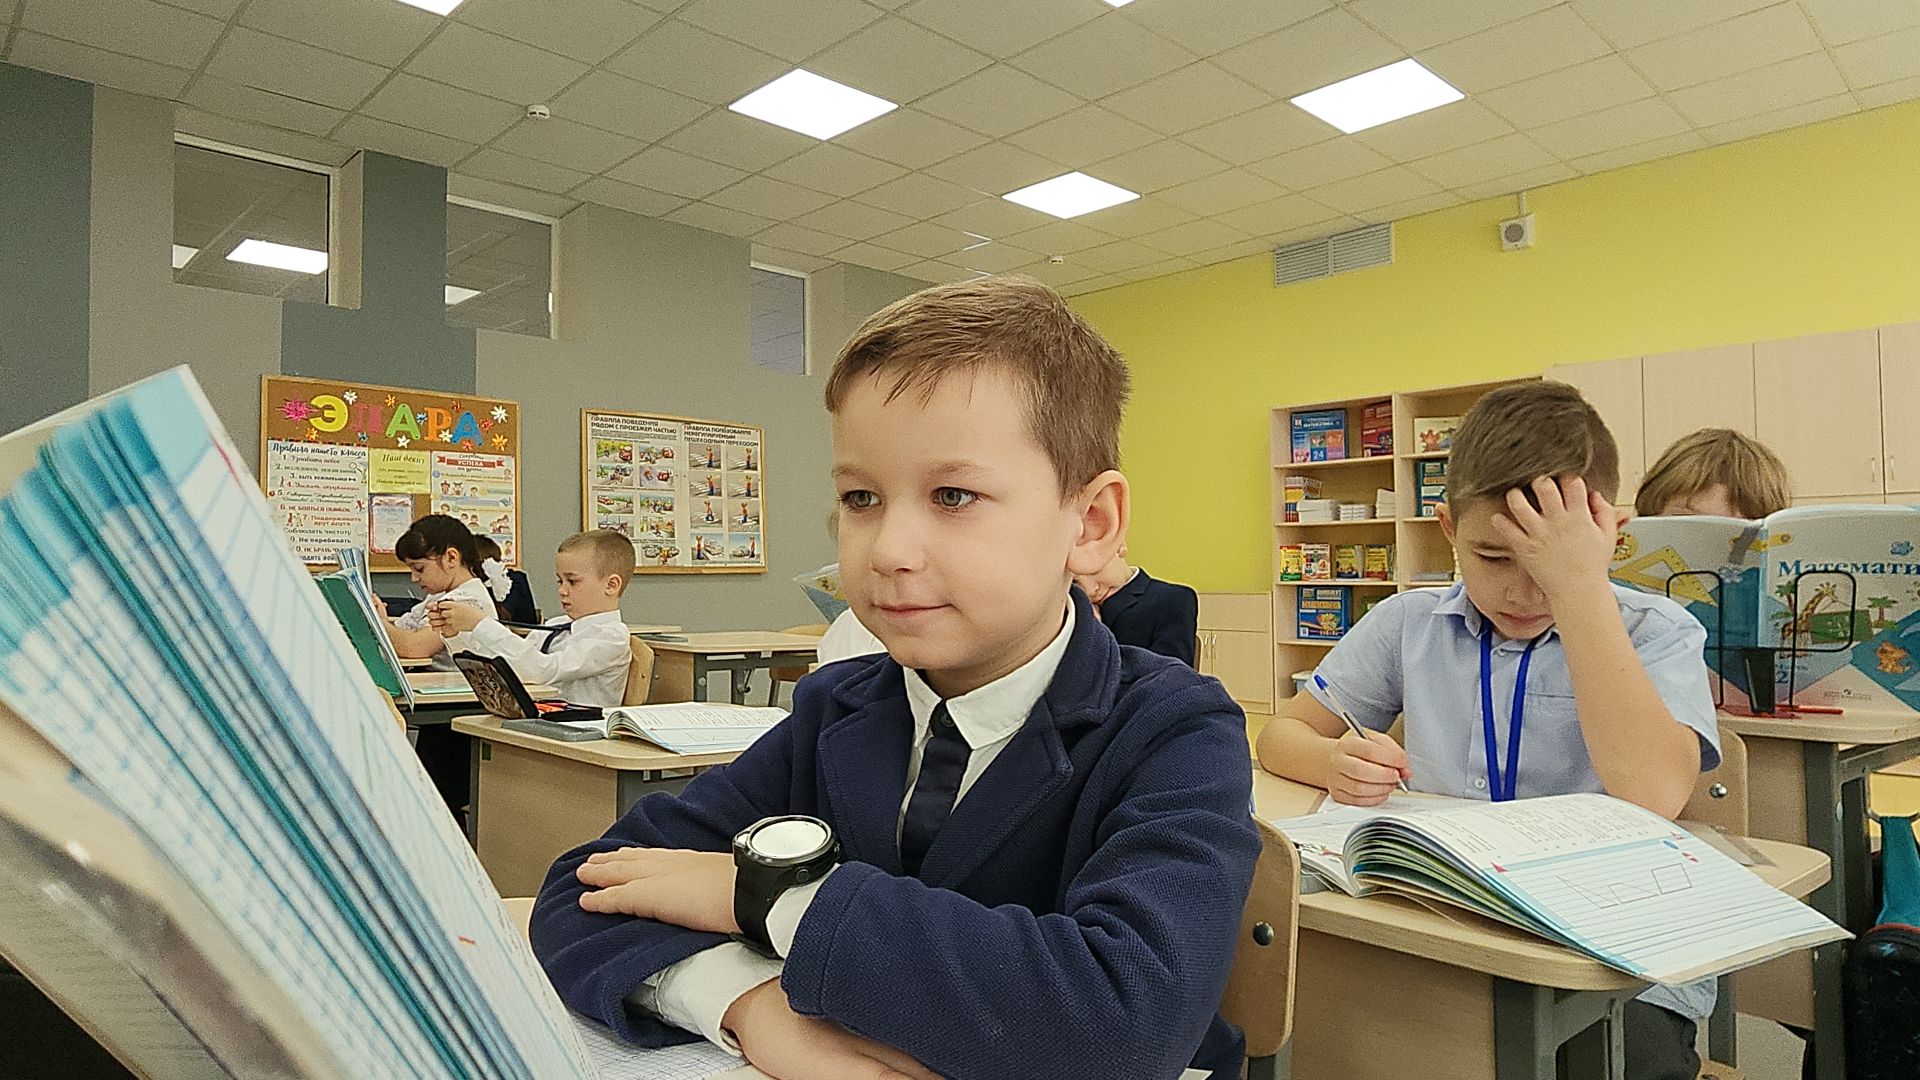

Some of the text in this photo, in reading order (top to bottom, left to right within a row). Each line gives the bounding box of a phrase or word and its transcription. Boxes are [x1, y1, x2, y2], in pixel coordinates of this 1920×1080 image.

[591, 415, 659, 427] ПРАВИЛА ПОВЕДЕНИЯ
[272, 442, 309, 455] Правила
[1775, 671, 1789, 684] 2
